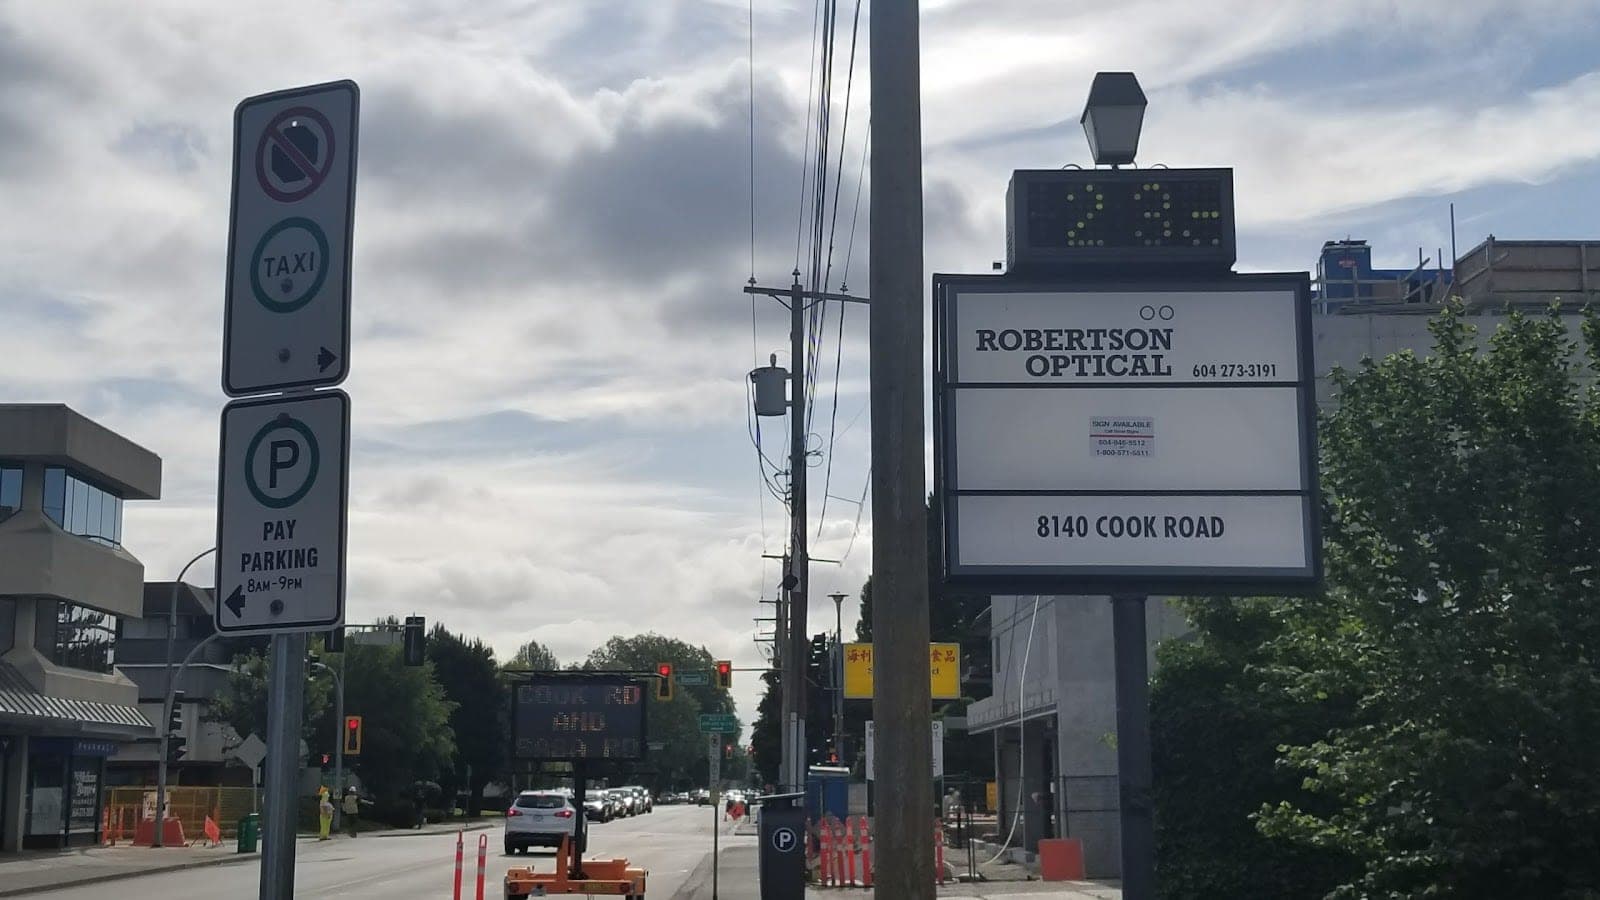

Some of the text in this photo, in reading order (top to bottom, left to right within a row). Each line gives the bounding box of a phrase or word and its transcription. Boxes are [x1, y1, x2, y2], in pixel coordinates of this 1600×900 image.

[263, 251, 315, 278] TAXI
[975, 328, 1174, 351] ROBERTSON
[1025, 354, 1172, 377] OPTICAL
[1193, 363, 1277, 378] 604 273-3191
[269, 439, 300, 489] P
[263, 519, 296, 541] PAY
[1037, 515, 1225, 538] 8140 COOK ROAD
[241, 547, 319, 572] PARKING
[604, 685, 641, 704] RD
[552, 711, 606, 732] AND
[779, 832, 791, 847] P
